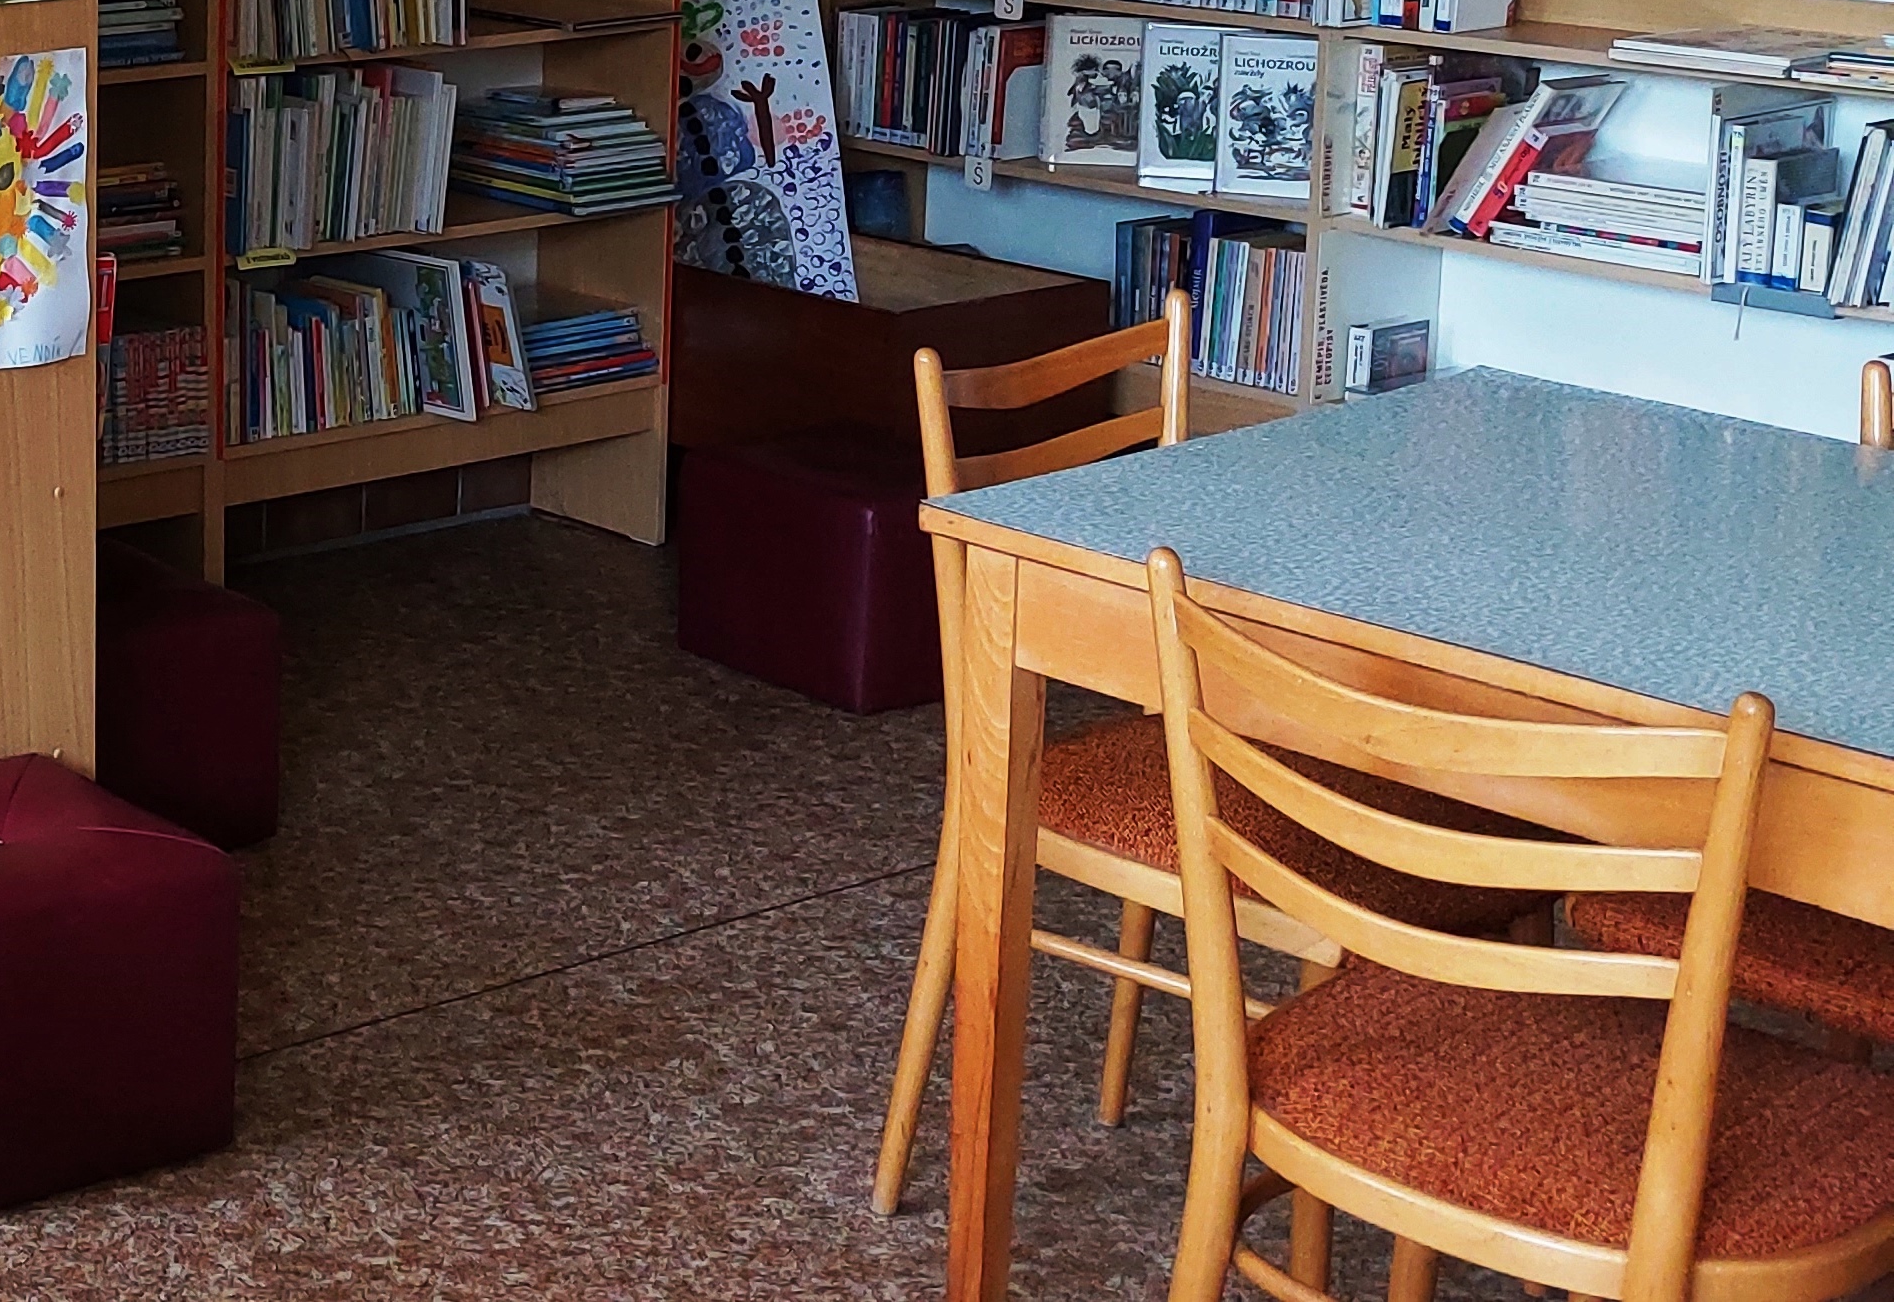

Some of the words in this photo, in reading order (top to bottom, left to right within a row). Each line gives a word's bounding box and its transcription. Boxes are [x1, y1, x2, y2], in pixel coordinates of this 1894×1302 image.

[1234, 58, 1315, 72] LICHOŽROU
[1402, 107, 1416, 150] Malý
[974, 161, 984, 186] Š
[1716, 150, 1728, 244] OSOBNOSTI
